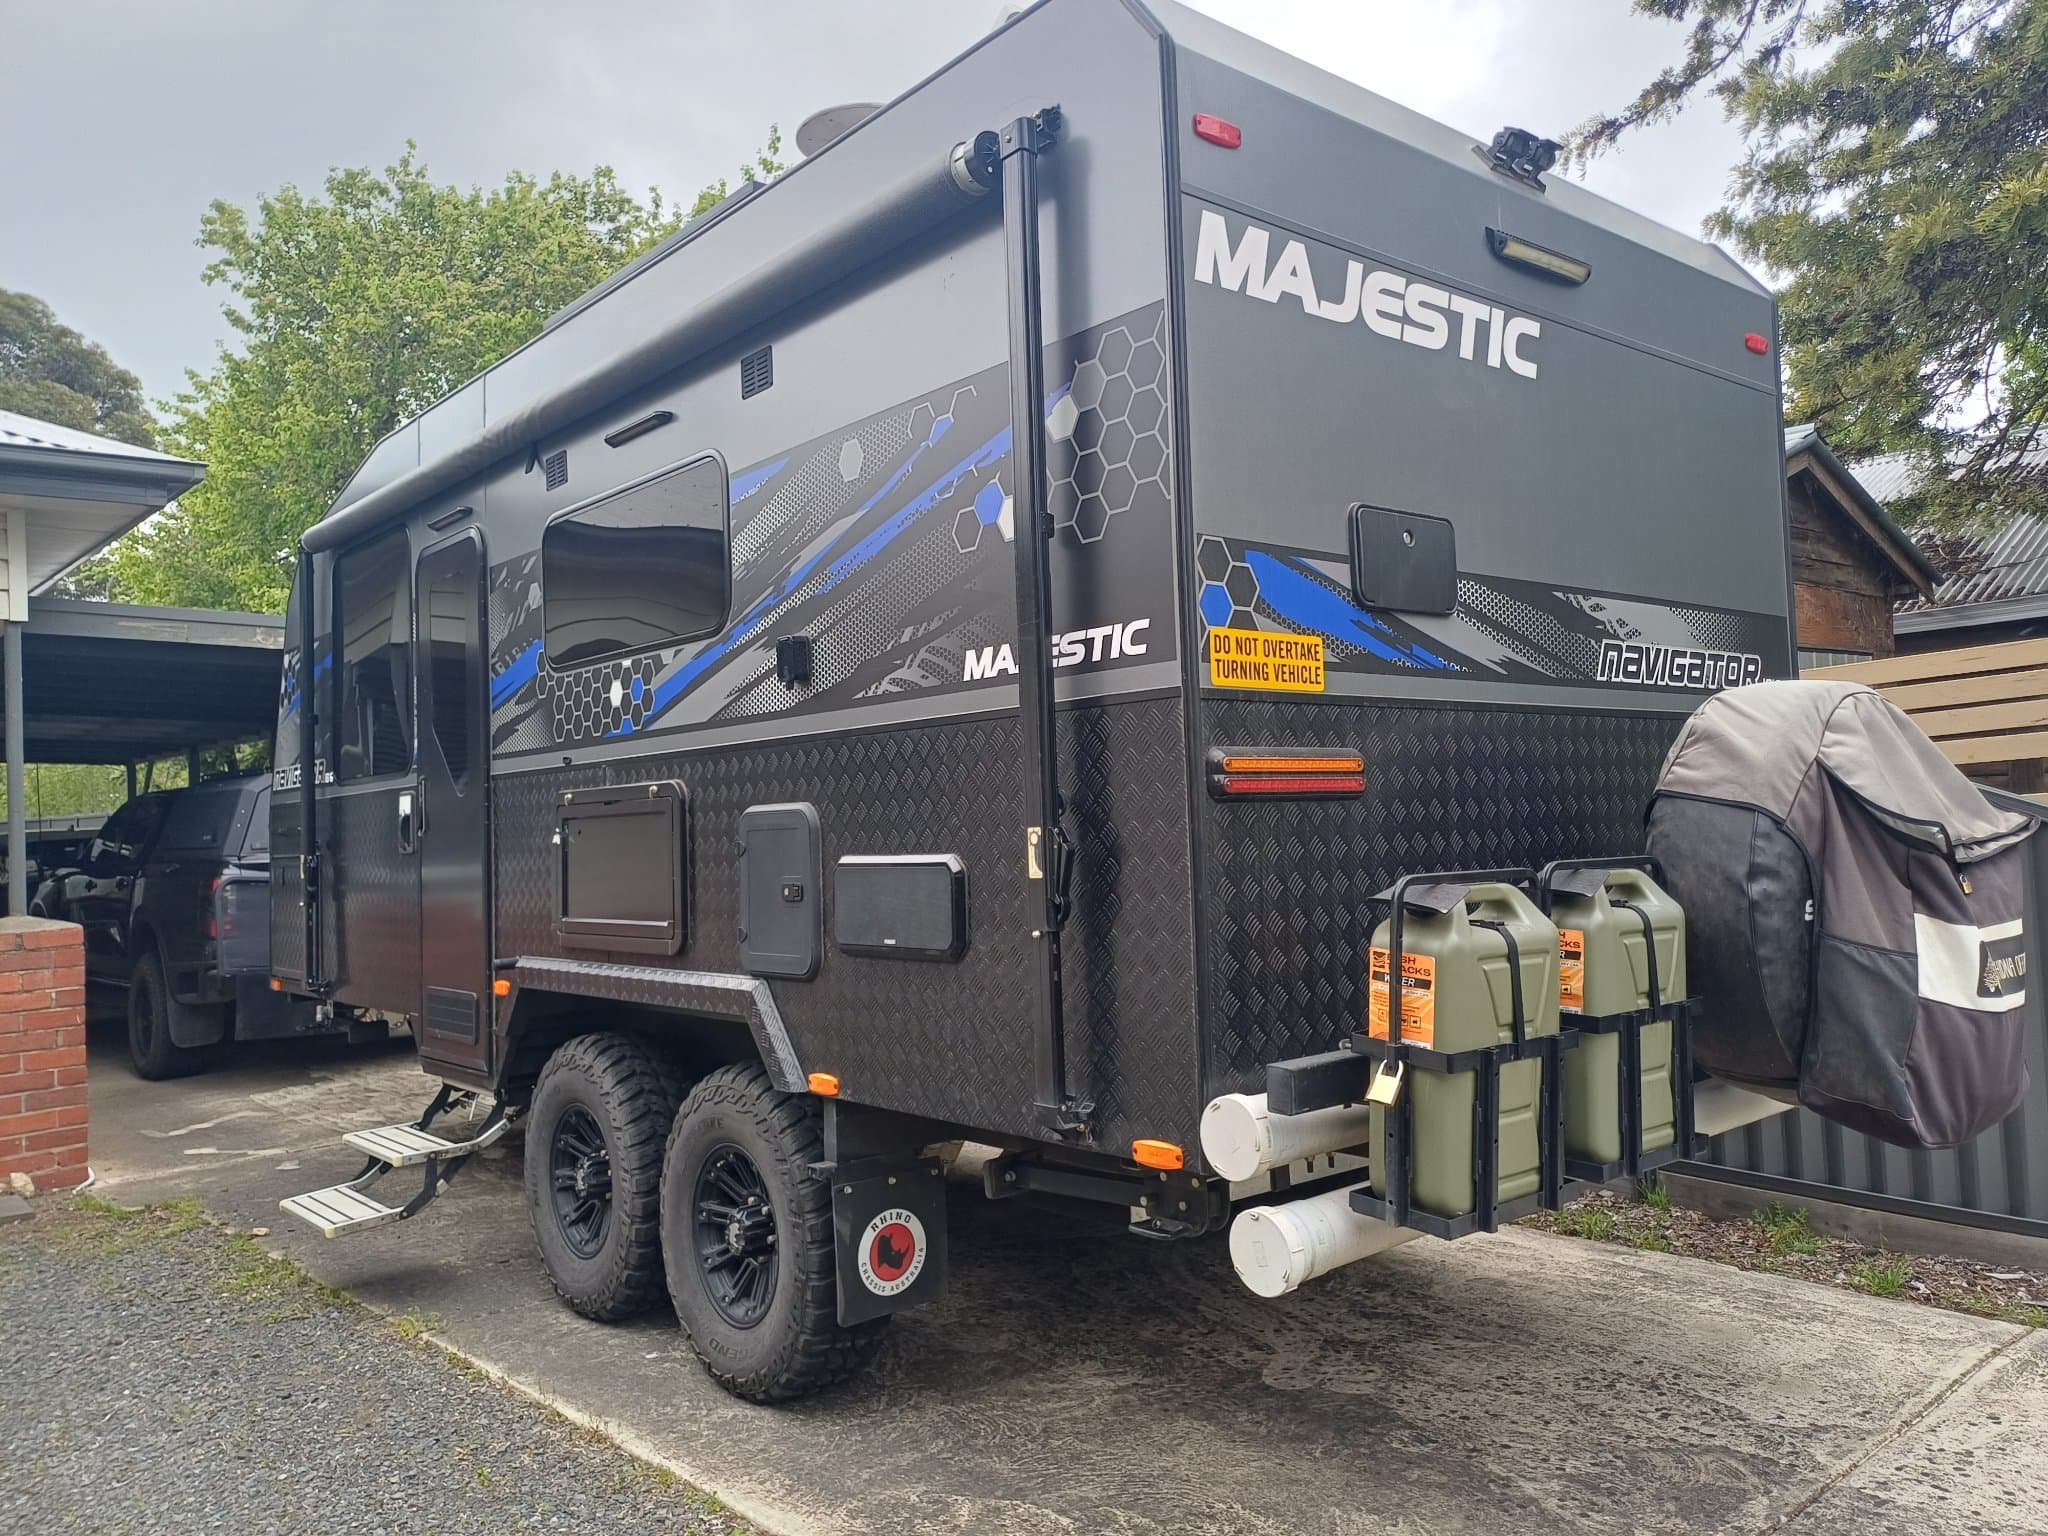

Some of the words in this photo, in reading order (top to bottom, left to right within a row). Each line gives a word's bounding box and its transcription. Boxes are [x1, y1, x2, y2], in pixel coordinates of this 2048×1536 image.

[1195, 210, 1541, 379] MAJESTIC
[963, 618, 1150, 682] MASTIC
[1213, 634, 1231, 654] DO
[1235, 636, 1259, 657] NOT
[1263, 639, 1320, 662] OVERTAKE
[1215, 659, 1269, 682] TURNING
[1273, 663, 1322, 685] VEHICLE
[870, 1211, 912, 1232] RHINO
